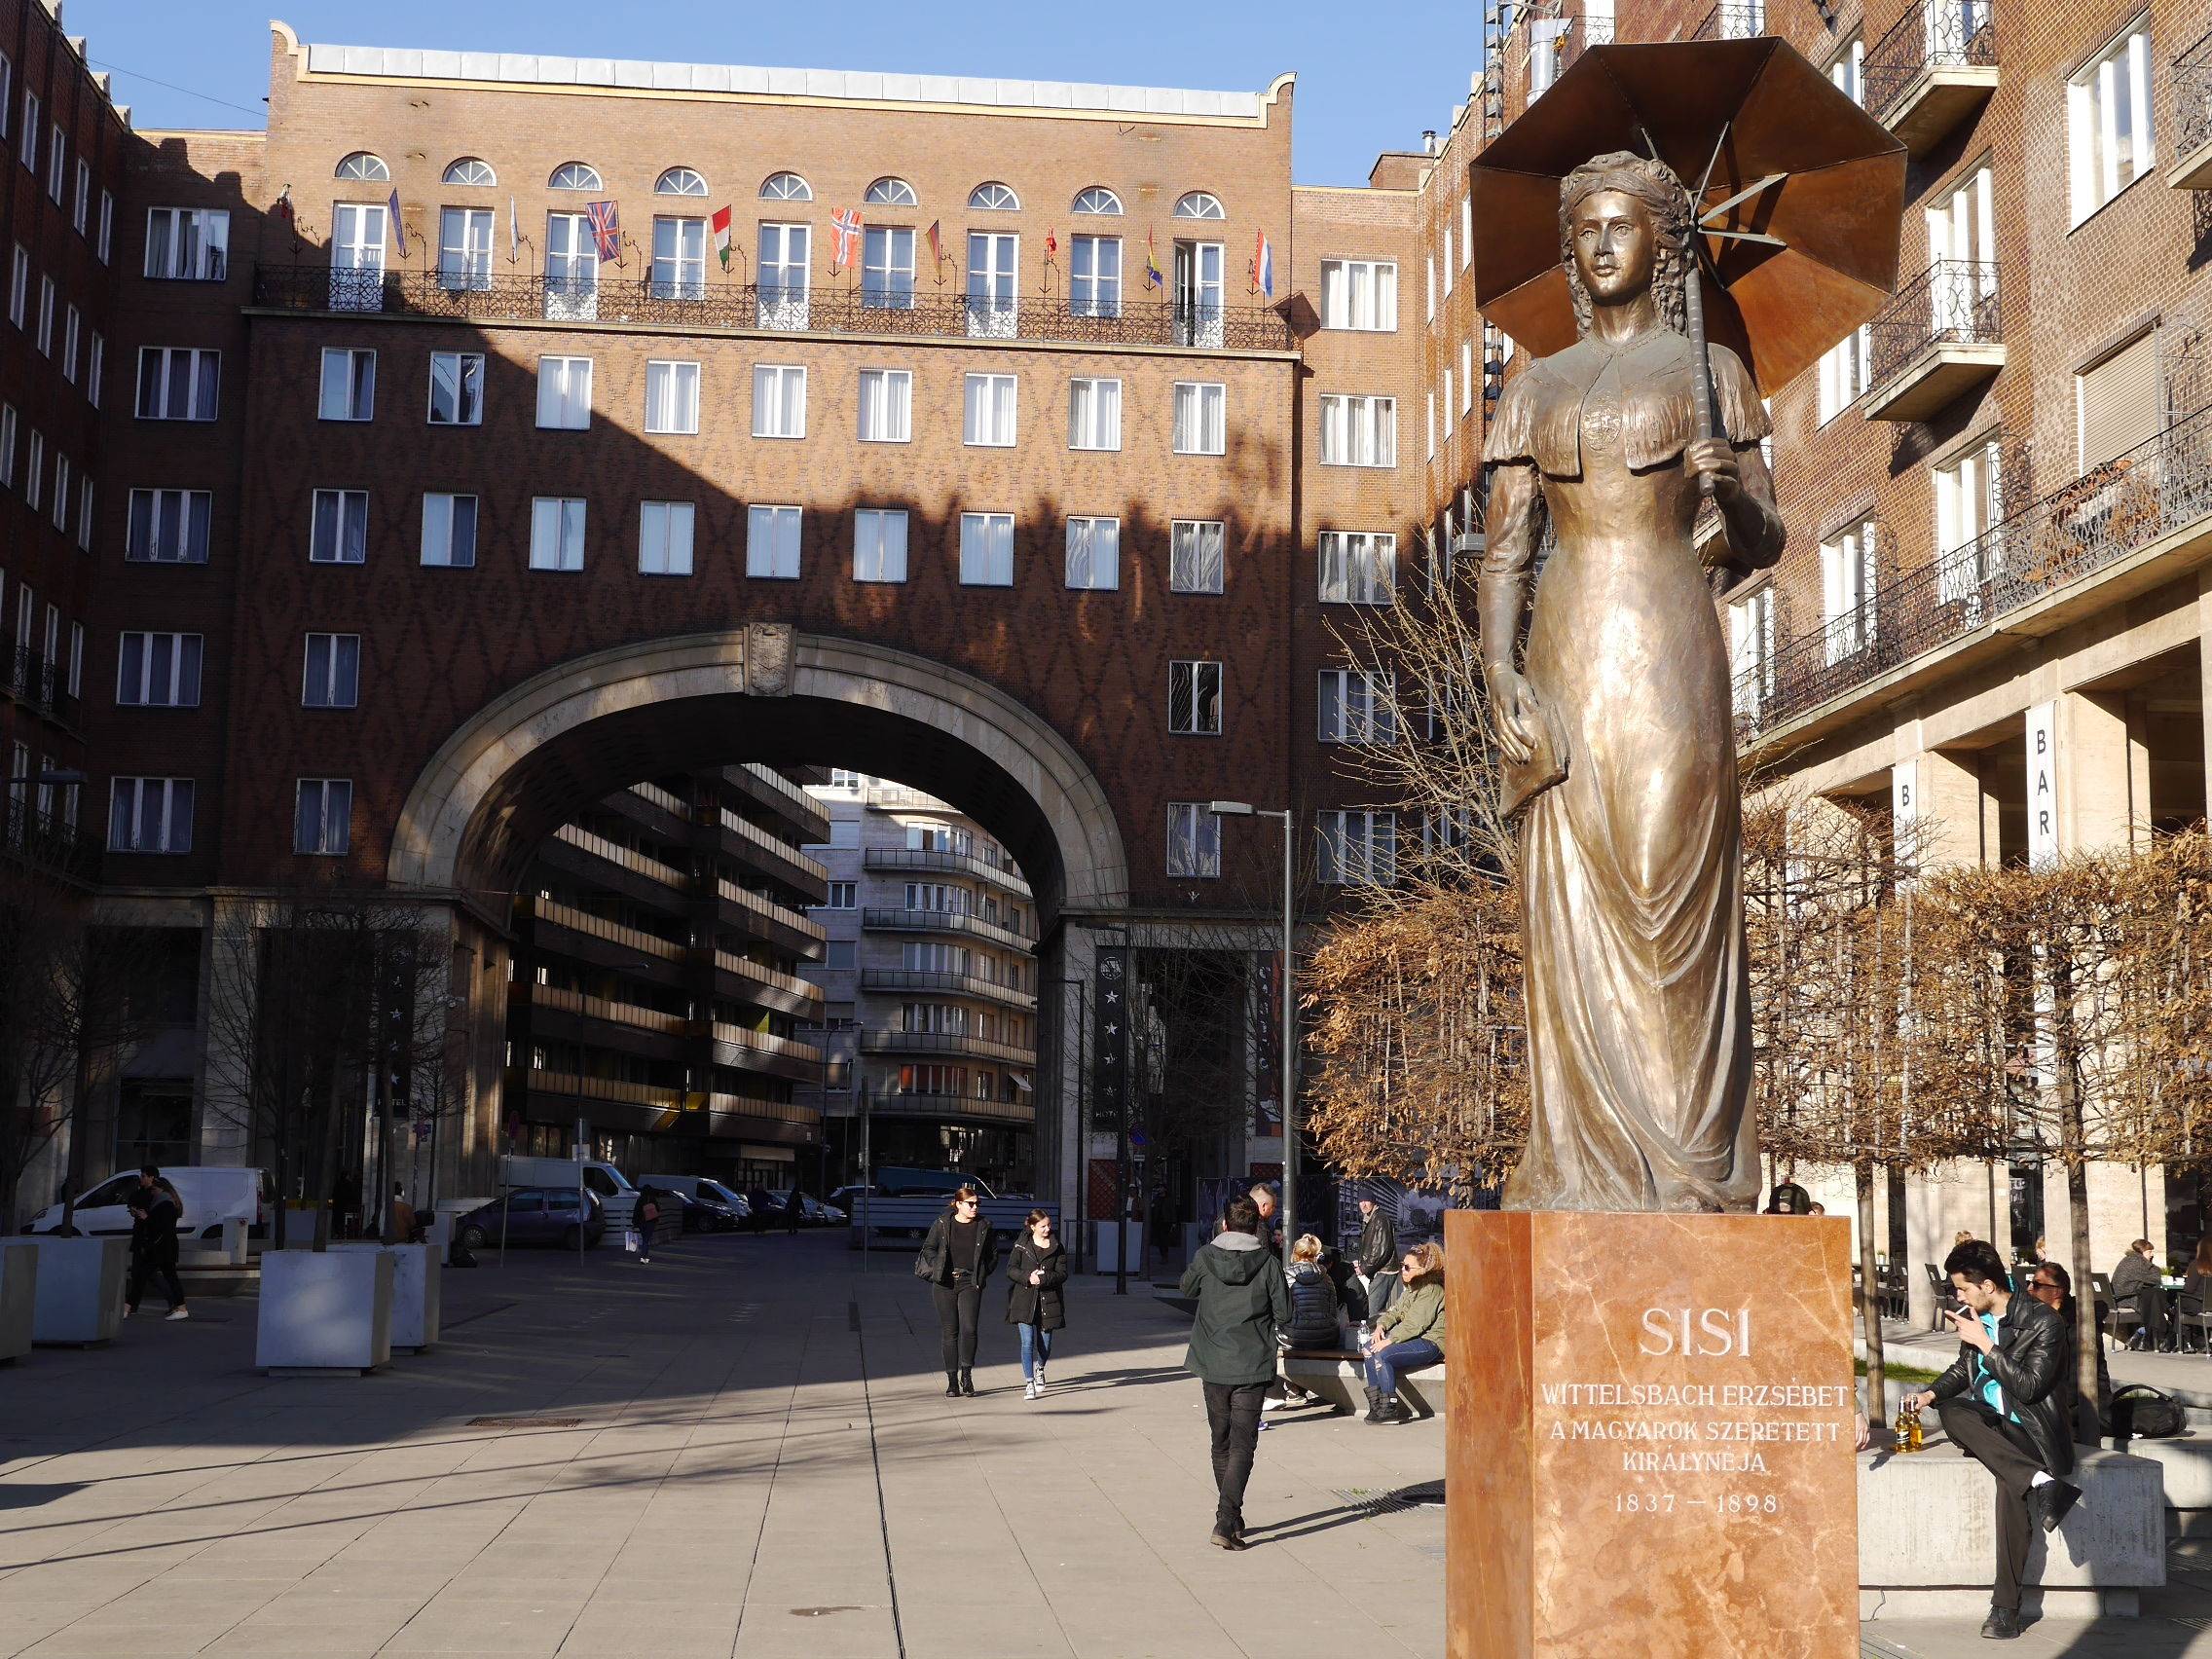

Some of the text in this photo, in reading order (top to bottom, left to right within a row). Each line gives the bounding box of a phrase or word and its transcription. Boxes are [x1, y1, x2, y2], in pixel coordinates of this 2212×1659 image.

[2037, 729, 2049, 835] BAR
[1639, 1308, 1751, 1357] SISI
[1541, 1377, 1848, 1408] WITTELSBACH ERZSÉBET
[1550, 1420, 1841, 1442] A MAGYAROK SZERETETT
[1622, 1444, 1767, 1473] KIRÁLYNÉJA
[1615, 1493, 1676, 1512] 1837
[1717, 1494, 1777, 1513] 1898
